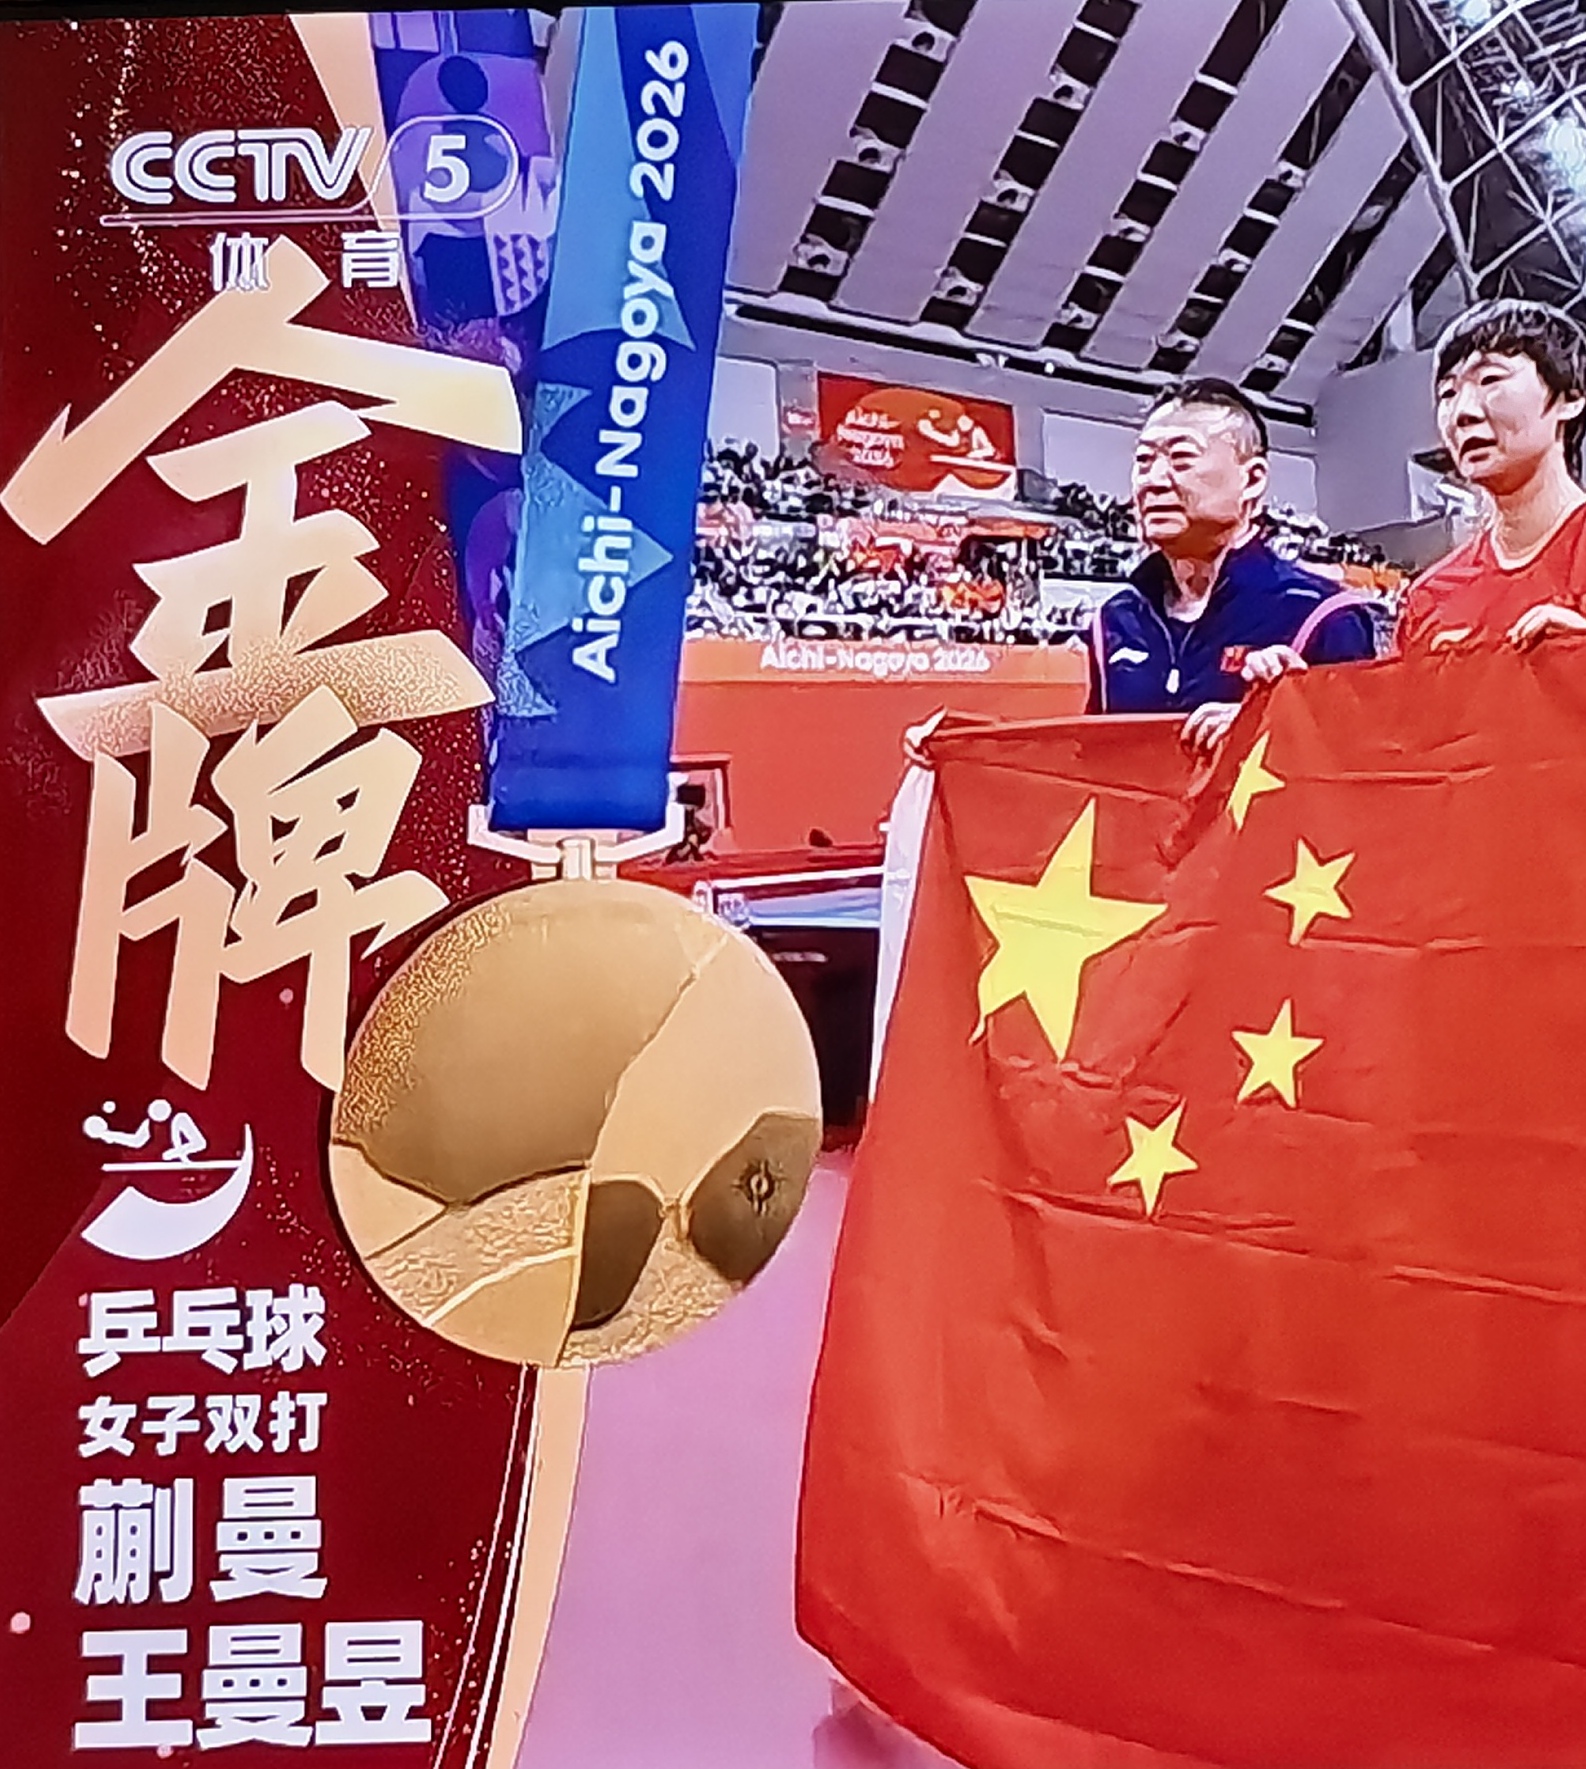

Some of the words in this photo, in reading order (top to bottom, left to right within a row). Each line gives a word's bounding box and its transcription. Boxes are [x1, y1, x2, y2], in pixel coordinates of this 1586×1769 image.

[110, 128, 373, 204] CCTV
[422, 135, 470, 202] 5
[209, 231, 400, 292] 体育
[572, 220, 677, 684] Aichi-Nagoya
[630, 39, 690, 202] 2026
[1, 236, 522, 1093] 金牌
[761, 643, 930, 681] Aichi-Nagoya
[933, 648, 991, 672] 2026
[78, 1283, 327, 1378] 乒乓球
[78, 1391, 328, 1458] 女子双打
[73, 1475, 328, 1605] 蒯曼
[72, 1620, 432, 1750] 王曼昱
